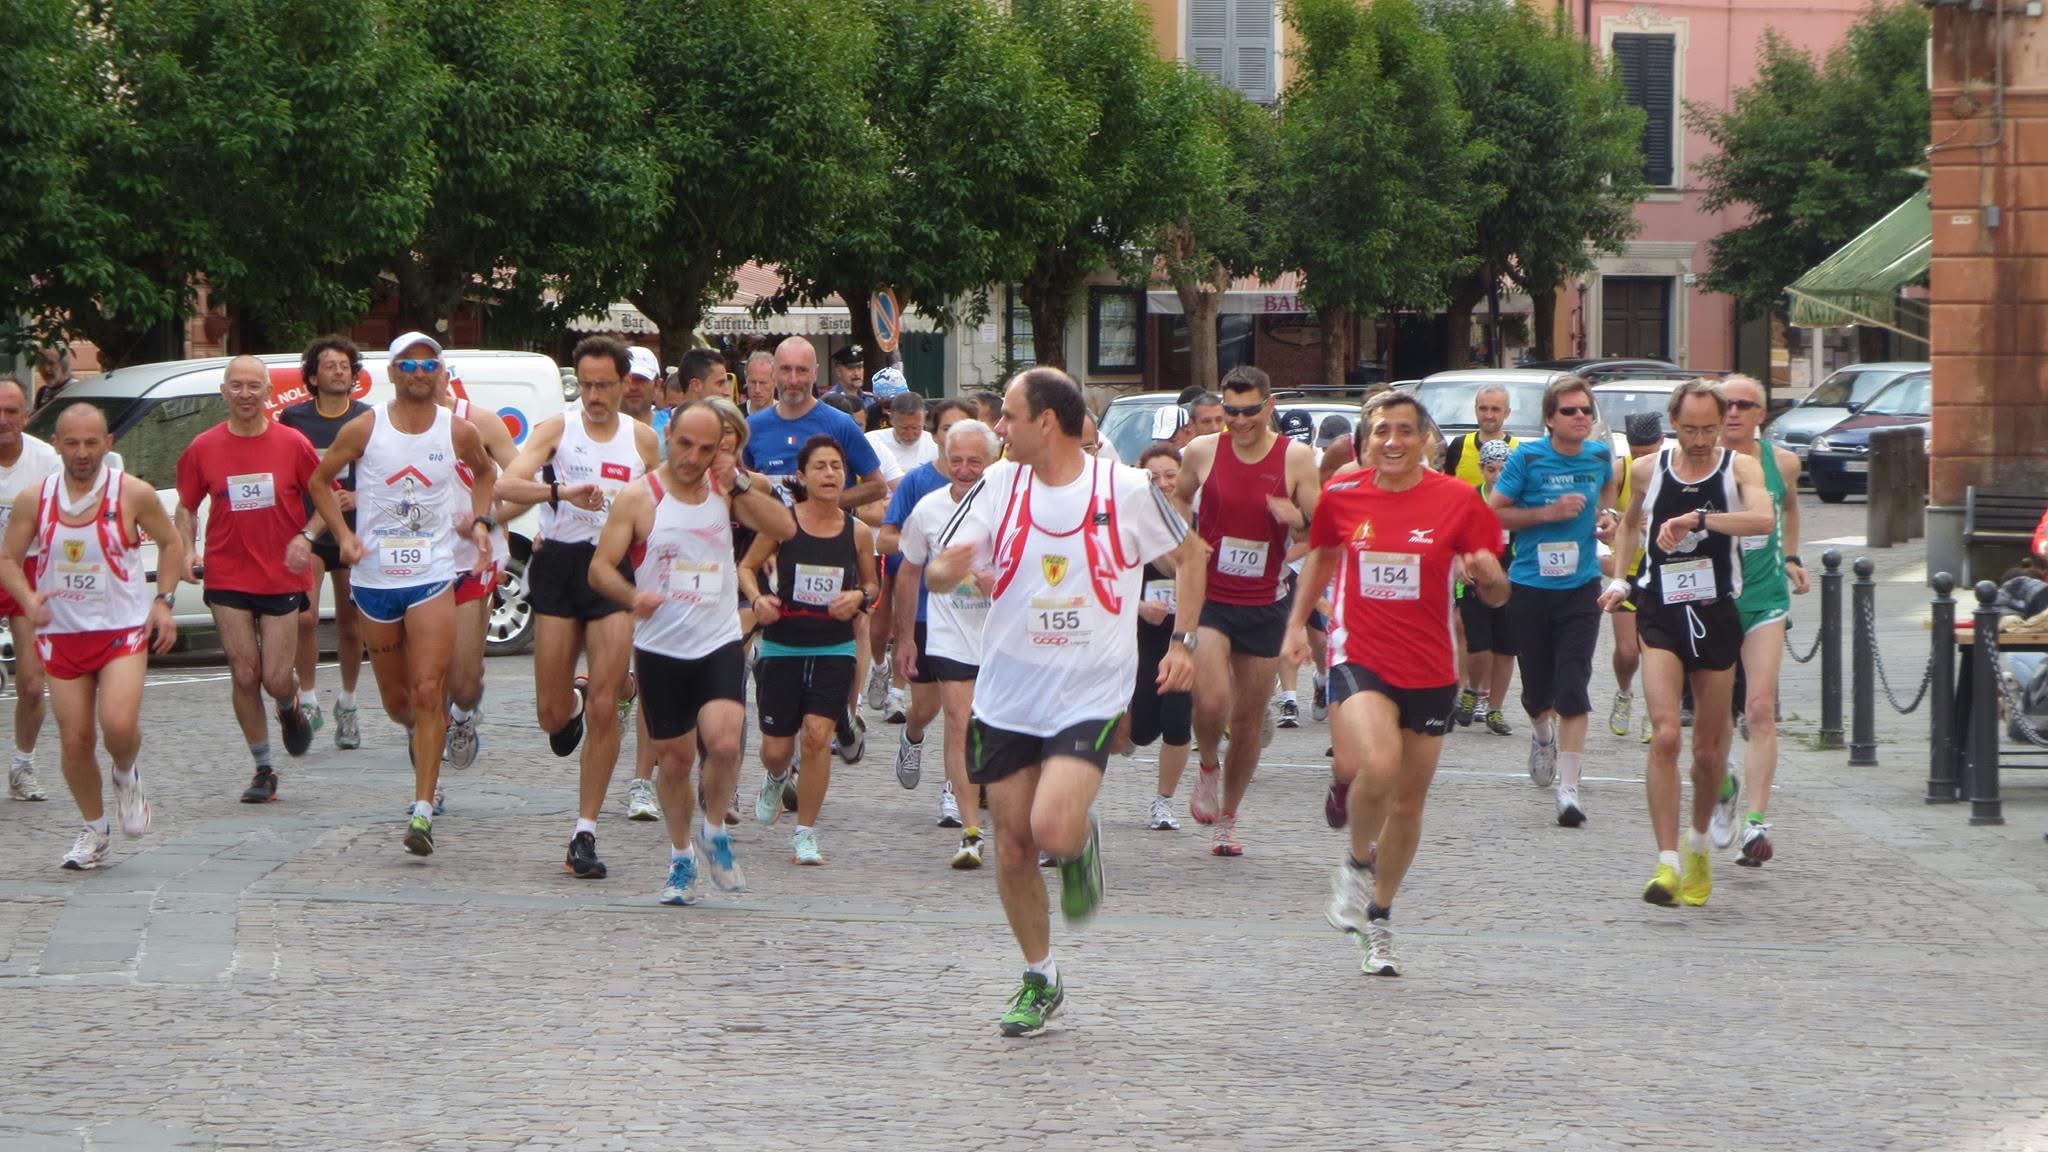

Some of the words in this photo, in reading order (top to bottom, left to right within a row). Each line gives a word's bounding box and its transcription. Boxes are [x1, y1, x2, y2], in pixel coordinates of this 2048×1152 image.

[1264, 296, 1305, 311] BAR
[622, 314, 645, 328] Bar
[242, 484, 260, 497] 34
[390, 549, 421, 563] 159
[1229, 549, 1258, 565] 170
[1549, 553, 1566, 565] 31
[64, 575, 96, 589] 152
[692, 573, 700, 590] 1
[1372, 566, 1408, 584] 154
[1677, 573, 1697, 589] 21
[804, 578, 833, 593] 153
[1039, 611, 1080, 630] 155
